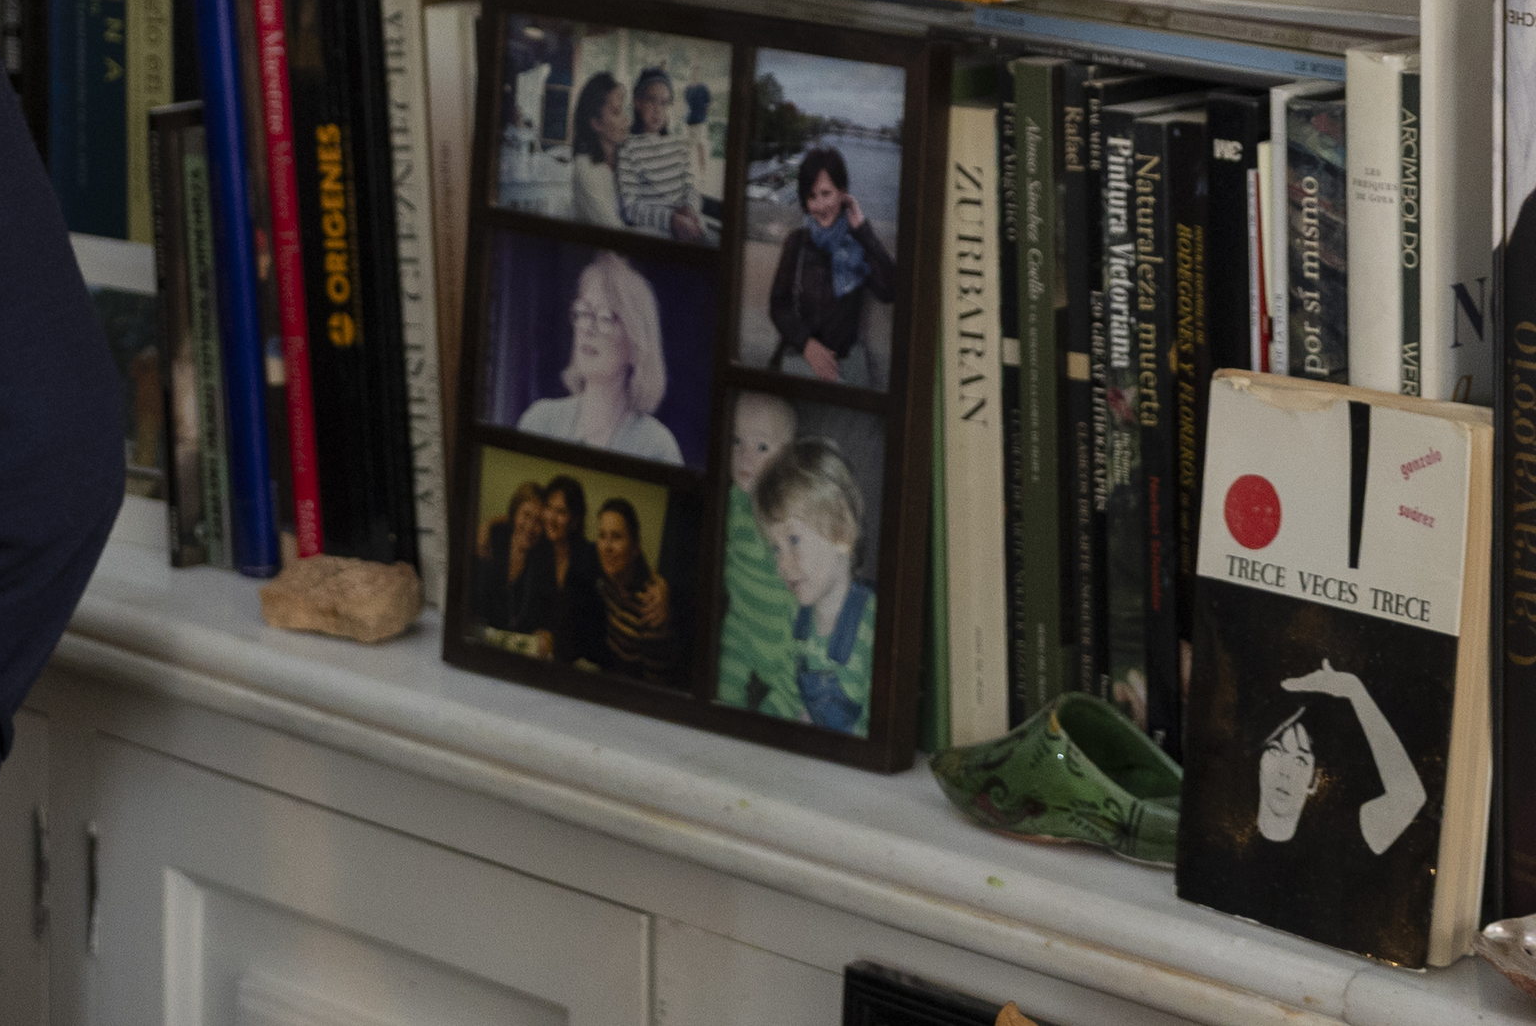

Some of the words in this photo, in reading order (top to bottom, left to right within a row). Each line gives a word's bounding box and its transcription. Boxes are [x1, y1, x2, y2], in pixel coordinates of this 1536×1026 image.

[1025, 116, 1043, 174] Alonso
[1063, 105, 1086, 172] Rafael
[1106, 136, 1135, 235] Pintura
[317, 124, 351, 304] ORIGENES
[1025, 177, 1045, 242] Sánchez
[1134, 152, 1165, 312] Naturaleza
[1295, 176, 1321, 281] mismo
[1401, 108, 1420, 271] ARCIMBOLDO
[954, 161, 989, 429] ZURBARAN
[1027, 246, 1047, 302] Coello
[1108, 242, 1137, 370] Victoriana
[1176, 222, 1195, 354] BODEGONES
[1297, 285, 1322, 314] sí
[1137, 321, 1162, 428] muerta
[1178, 361, 1195, 376] Y
[1303, 321, 1330, 376] por
[1179, 380, 1196, 489] FLOREROS
[1399, 446, 1443, 481] gonzalo
[1226, 553, 1287, 589] TRECE
[1298, 570, 1360, 605] VECES
[1369, 586, 1431, 624] TRECE
